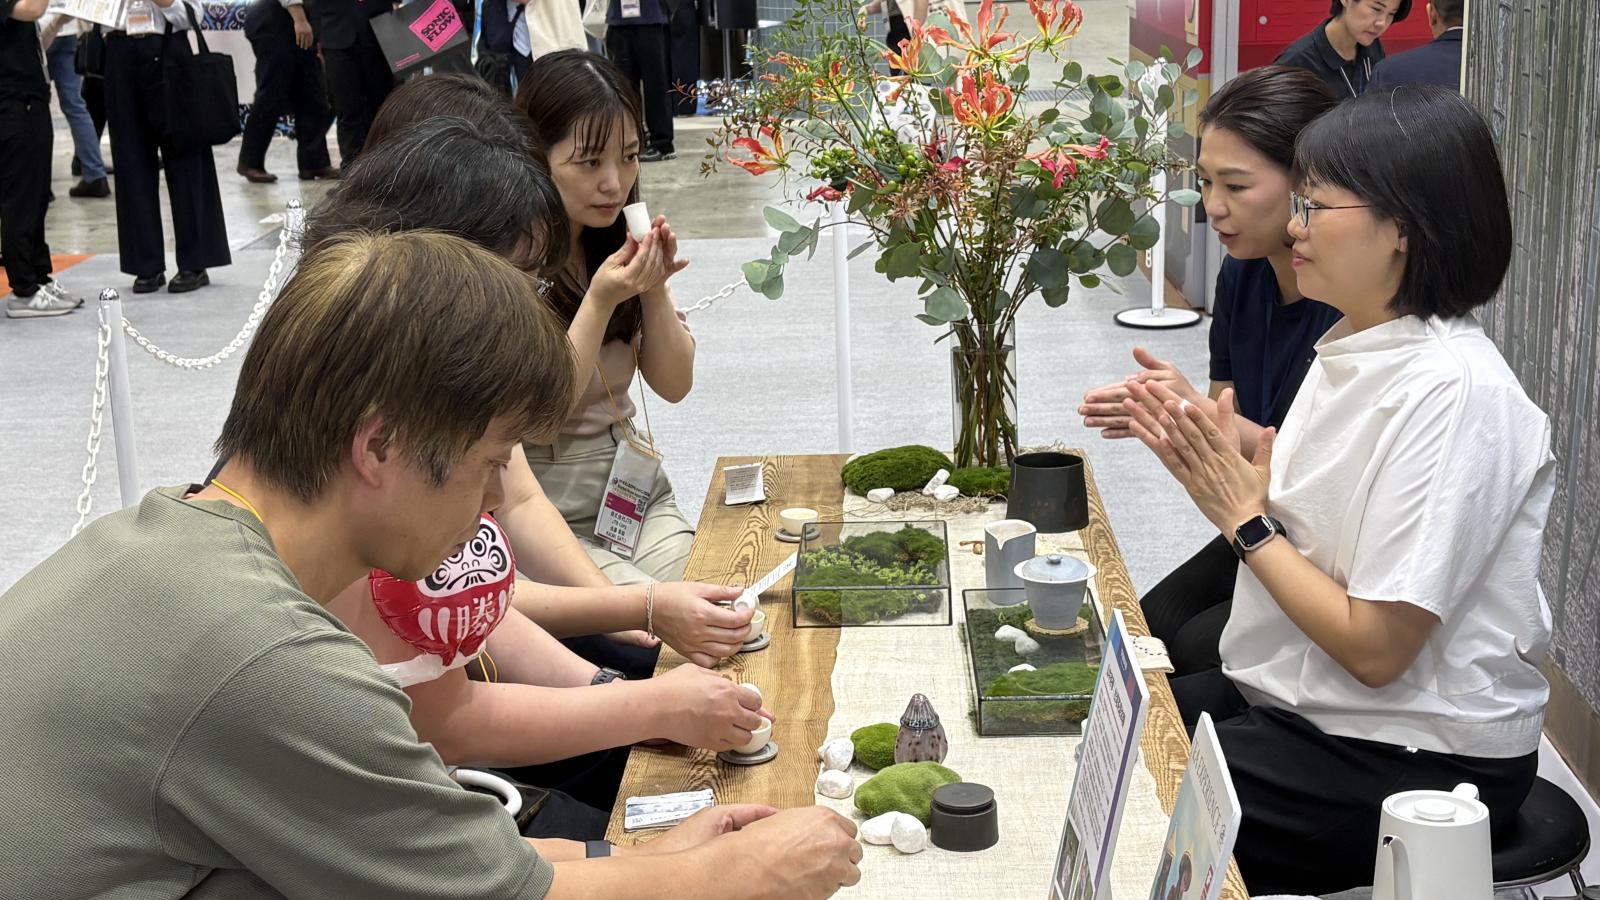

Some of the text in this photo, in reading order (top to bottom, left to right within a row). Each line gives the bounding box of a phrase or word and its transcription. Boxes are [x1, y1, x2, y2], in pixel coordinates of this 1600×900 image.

[421, 7, 451, 36] SONIC
[427, 12, 456, 42] FLOW
[457, 592, 495, 640] 勝
[1196, 758, 1222, 835] EXPERIENCE
